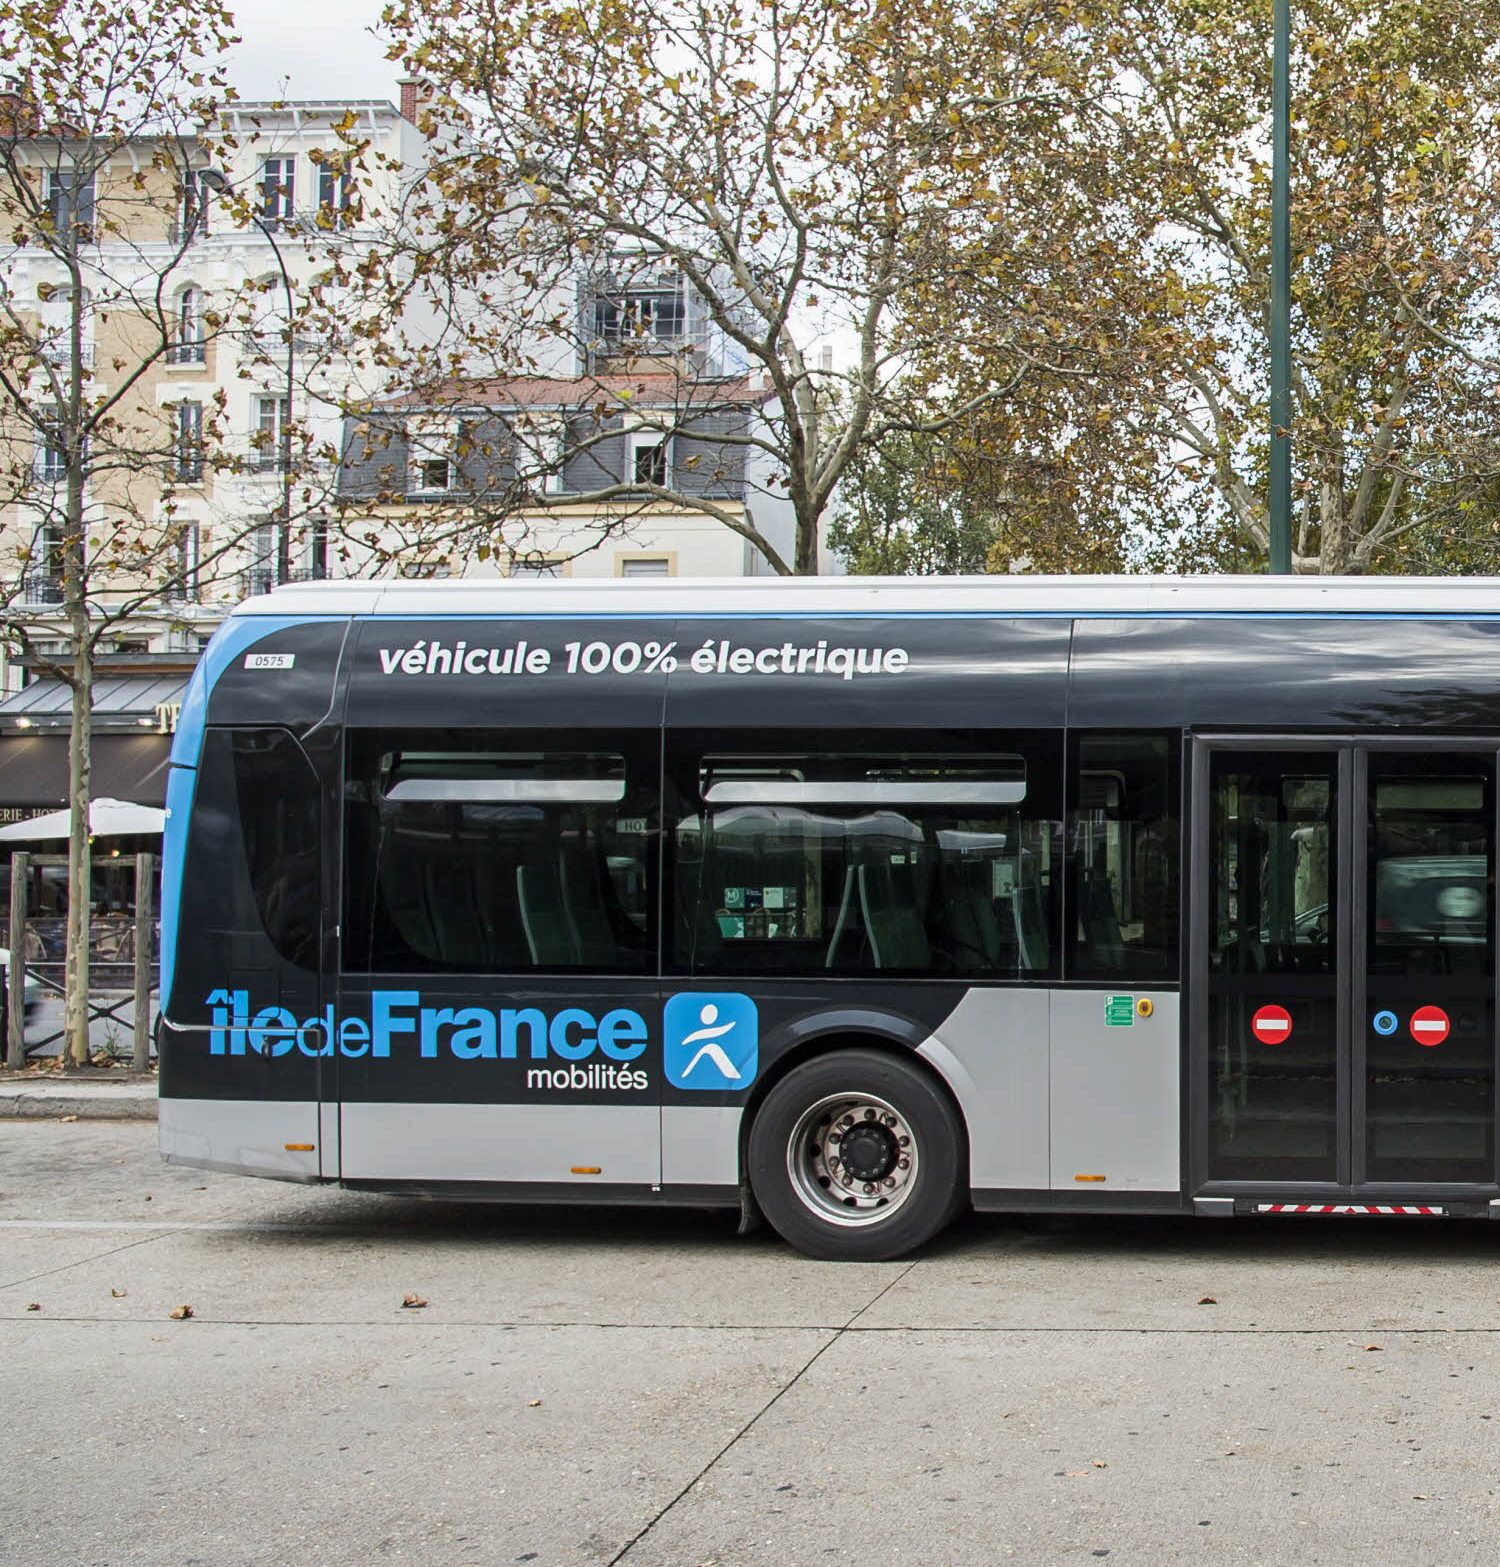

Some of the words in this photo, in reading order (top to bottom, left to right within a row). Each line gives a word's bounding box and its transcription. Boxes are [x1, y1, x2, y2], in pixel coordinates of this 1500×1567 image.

[254, 656, 284, 666] 0575
[380, 641, 550, 674] véhicule
[564, 641, 678, 674] 100%
[690, 640, 909, 680] électrique
[528, 1063, 648, 1089] mobilités
